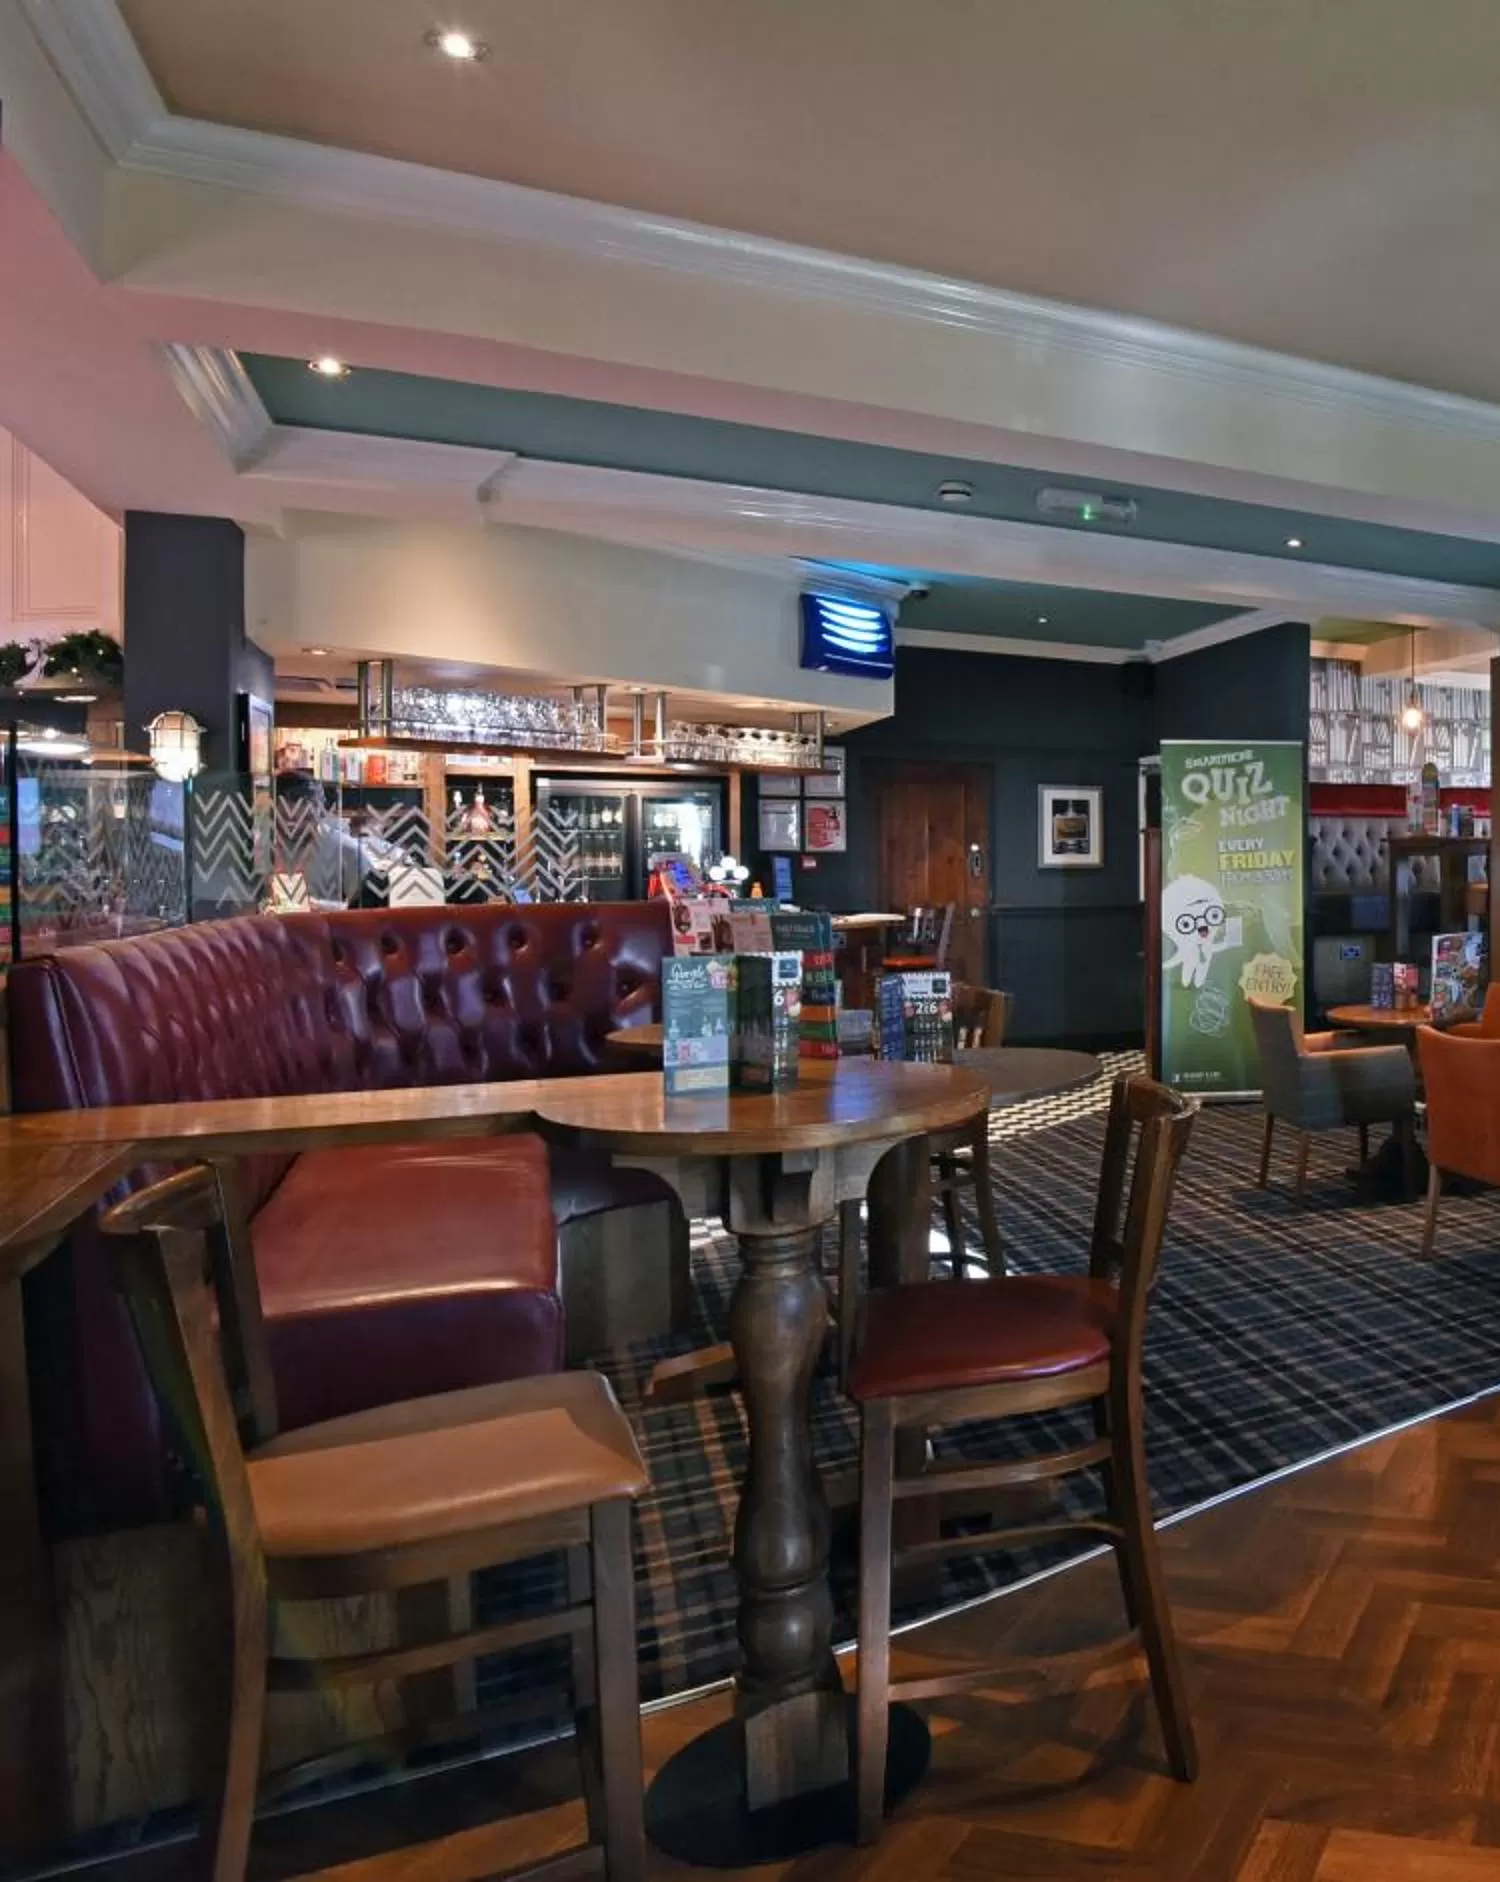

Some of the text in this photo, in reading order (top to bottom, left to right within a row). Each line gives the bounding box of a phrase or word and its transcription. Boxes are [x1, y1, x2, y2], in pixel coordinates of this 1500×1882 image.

[1181, 761, 1273, 805] QUIZ
[1219, 795, 1291, 827] NIGHT
[1218, 836, 1264, 852] EVERY
[1219, 849, 1295, 870] FRIDAY
[1254, 963, 1285, 978] FREE
